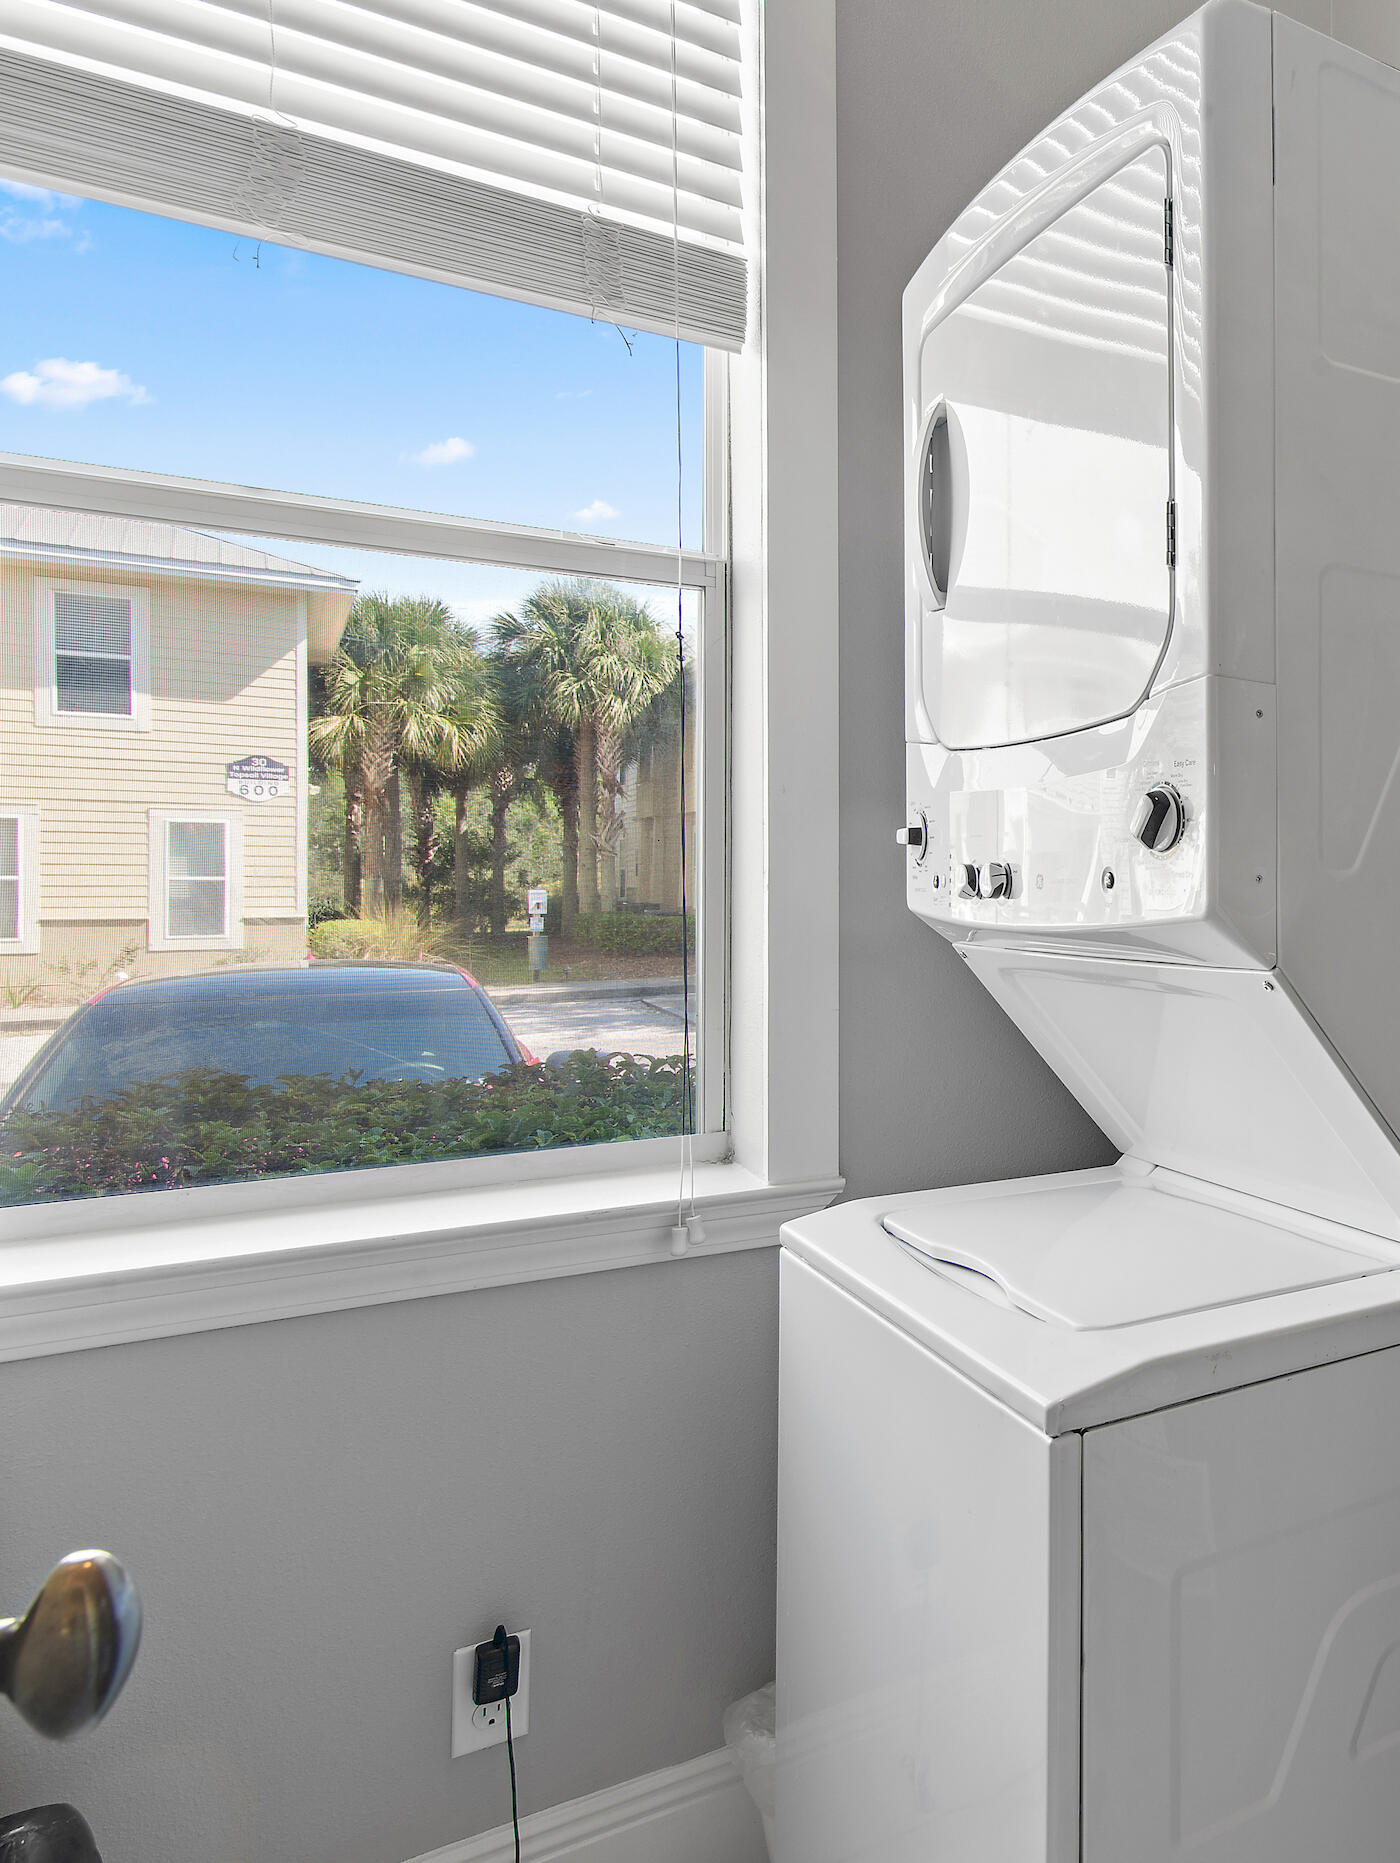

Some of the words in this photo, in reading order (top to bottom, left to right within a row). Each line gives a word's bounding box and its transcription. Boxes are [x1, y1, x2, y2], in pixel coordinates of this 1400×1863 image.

[251, 758, 267, 766] 30
[1173, 760, 1184, 768] Easy
[240, 785, 278, 796] 600
